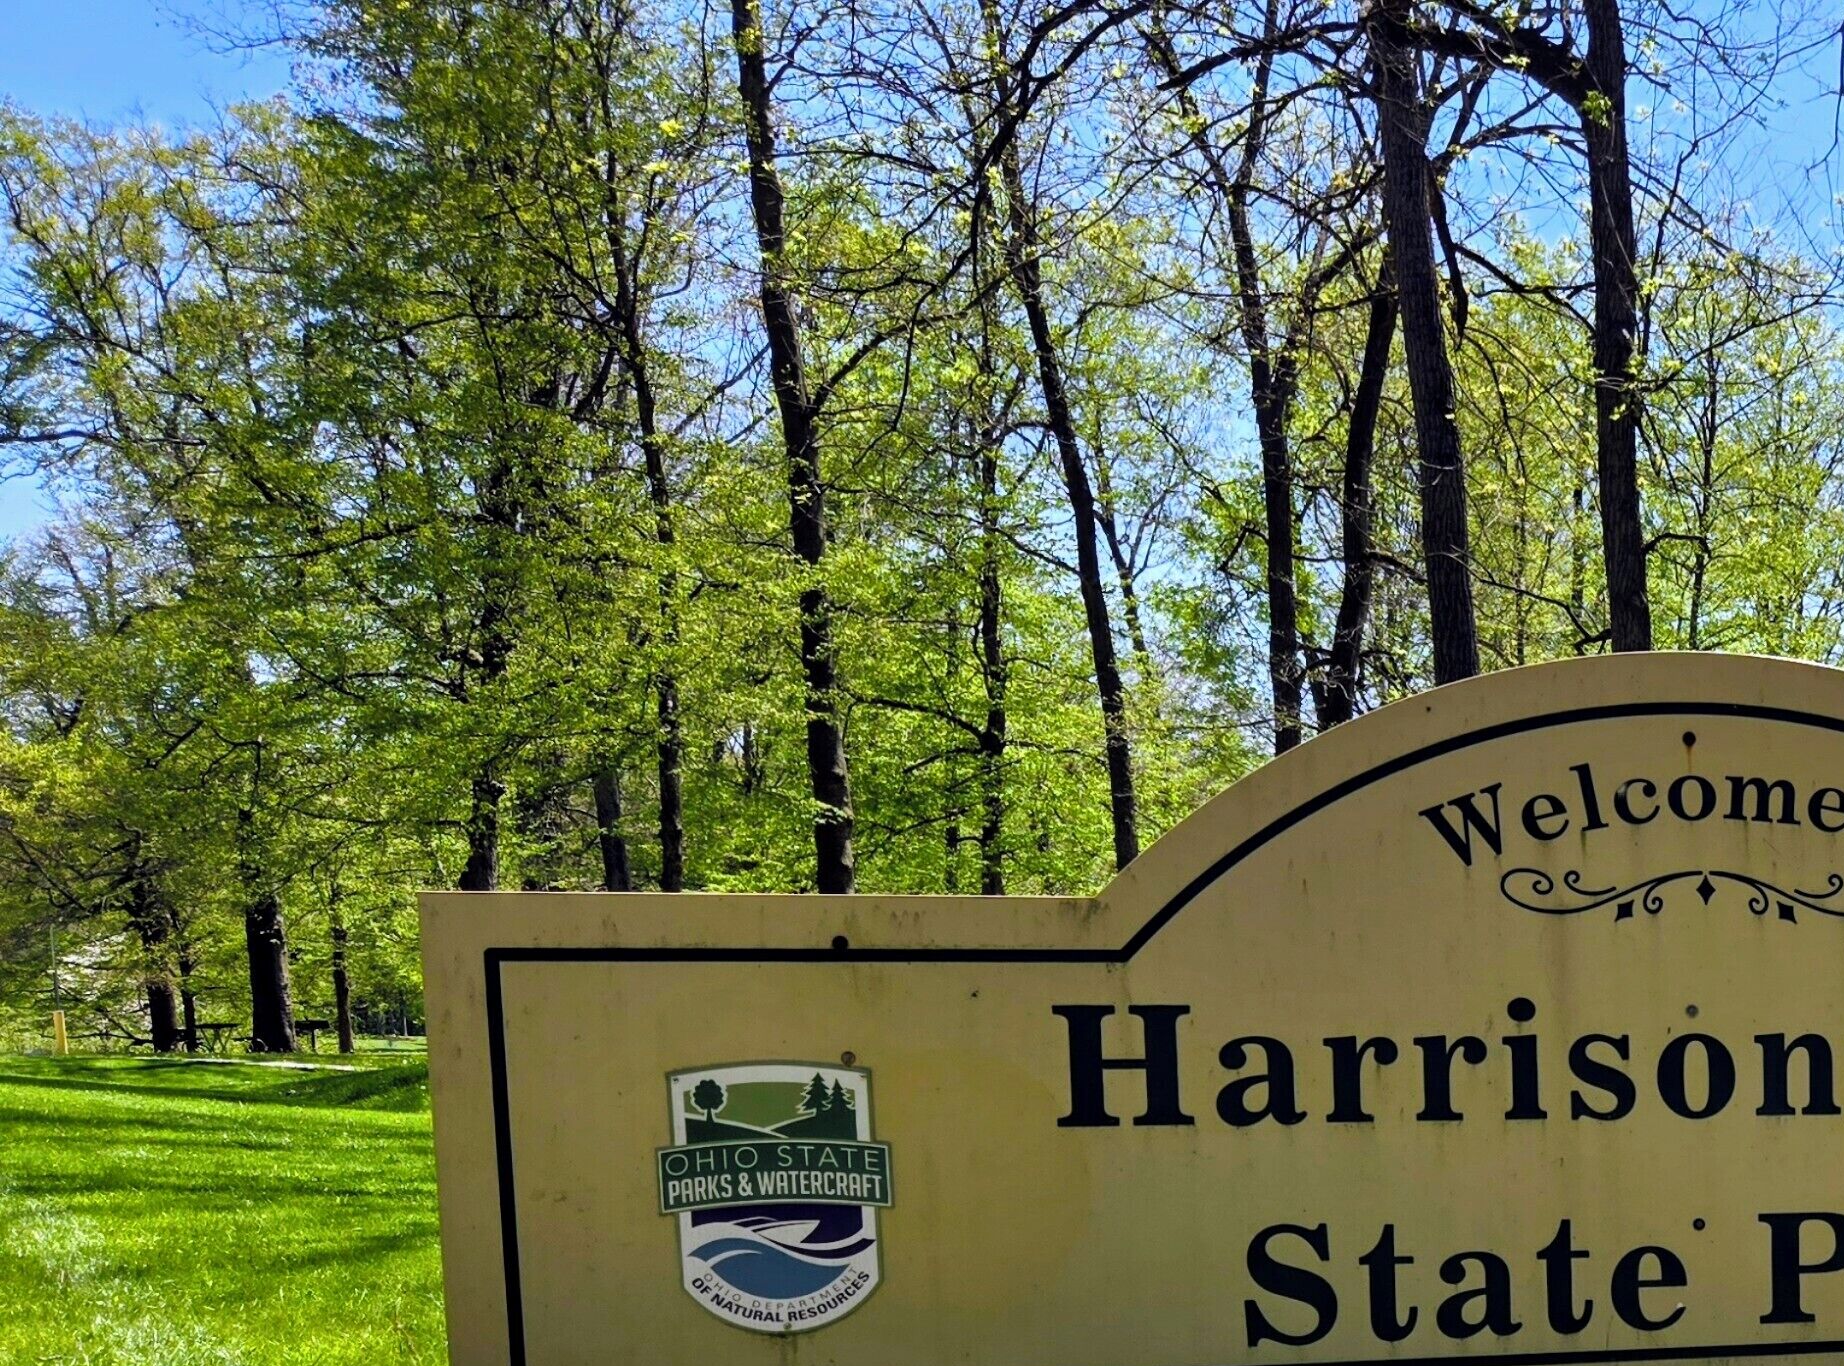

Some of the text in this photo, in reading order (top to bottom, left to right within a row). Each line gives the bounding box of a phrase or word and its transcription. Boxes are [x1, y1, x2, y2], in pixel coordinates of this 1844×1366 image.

[1051, 997, 1842, 1127] Harrison
[665, 1146, 880, 1176] OHIO STATE
[668, 1170, 882, 1205] PARKS & WATERCRAFT
[692, 1271, 870, 1322] OF NATURAL RESOURCES
[703, 1268, 858, 1310] OHIO DEPARTMENT
[1244, 1218, 1688, 1348] State
